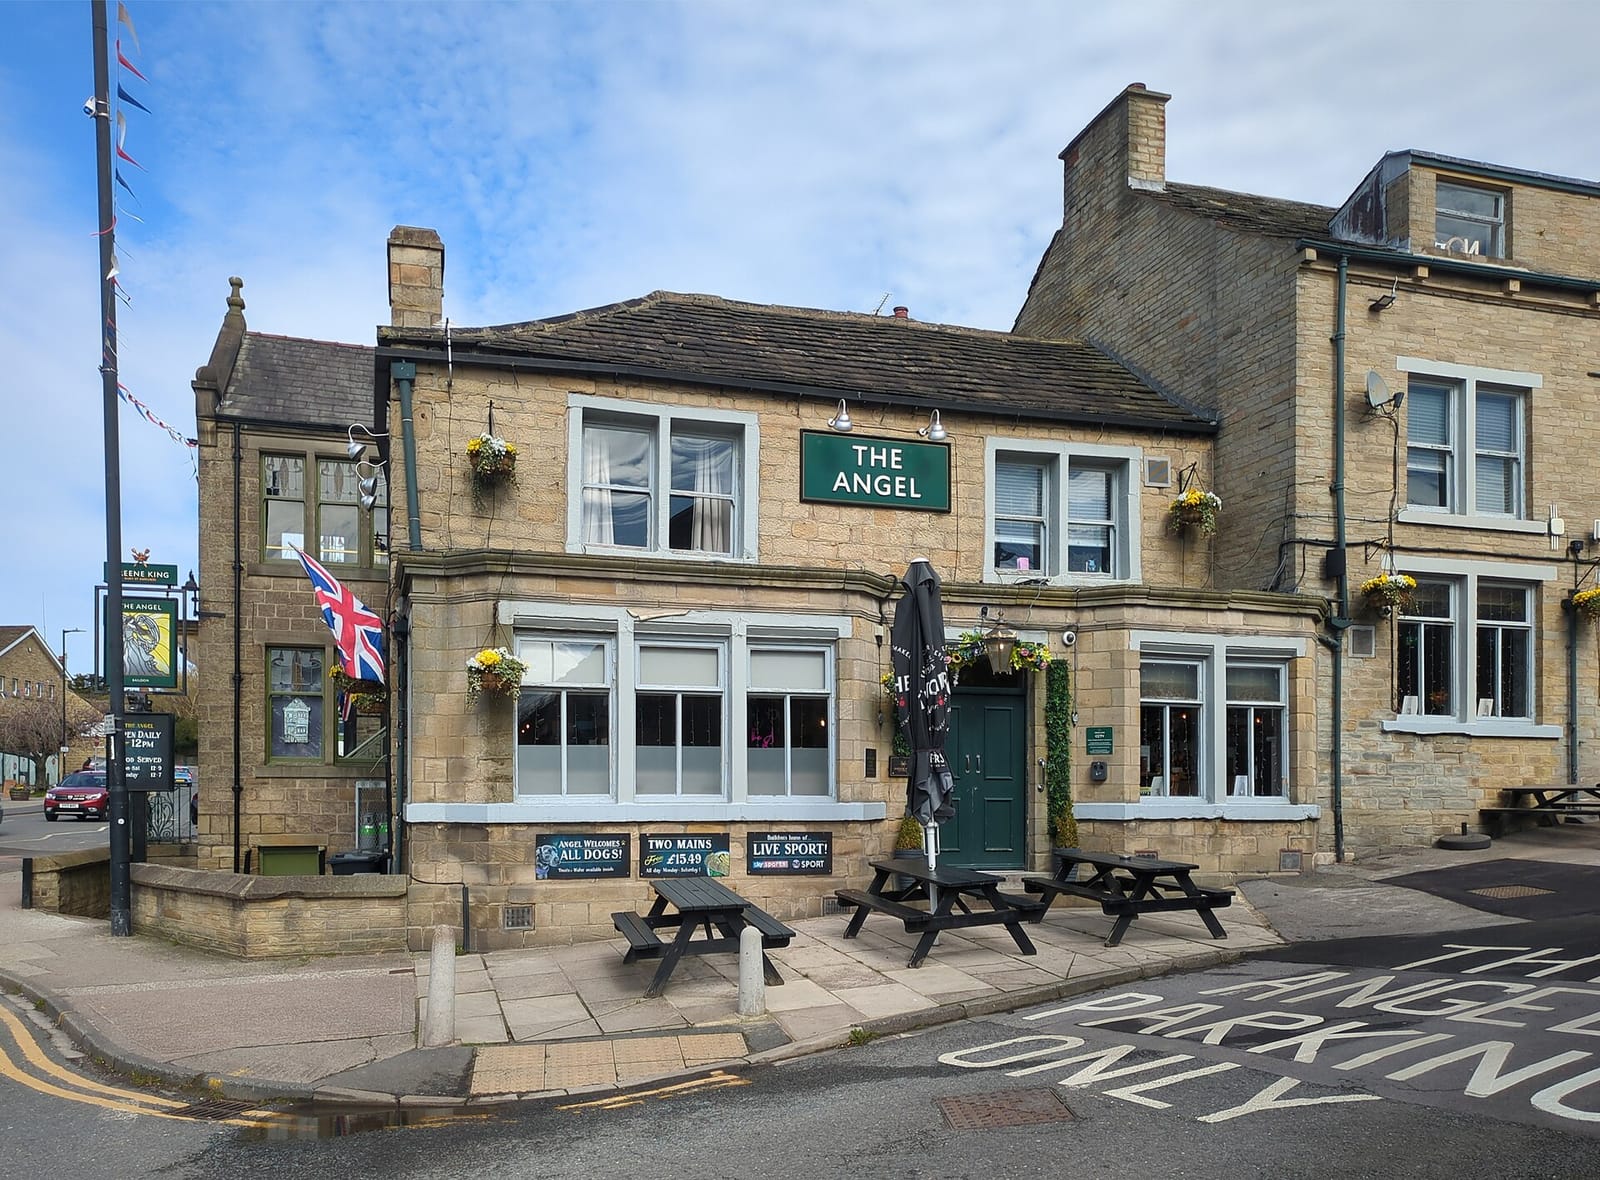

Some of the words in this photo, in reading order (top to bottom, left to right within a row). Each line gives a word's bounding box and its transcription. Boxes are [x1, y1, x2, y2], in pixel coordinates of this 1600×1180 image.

[852, 445, 903, 469] THE
[832, 471, 922, 498] ANGEL
[136, 603, 162, 611] ANGEL
[137, 730, 161, 739] DAILY
[131, 738, 154, 748] 12PM
[558, 840, 582, 848] ANGEL
[584, 839, 620, 848] WELCOMES
[648, 840, 672, 849] TWO
[677, 840, 712, 849] MAINS
[753, 843, 781, 855] LIVE
[784, 843, 828, 855] SPORT!
[560, 849, 582, 860] ALL
[584, 849, 623, 860] DOGS!
[666, 853, 702, 864] £15.49
[753, 861, 763, 869] sky
[801, 860, 824, 868] SPORT
[937, 1034, 1385, 1124] ONLY
